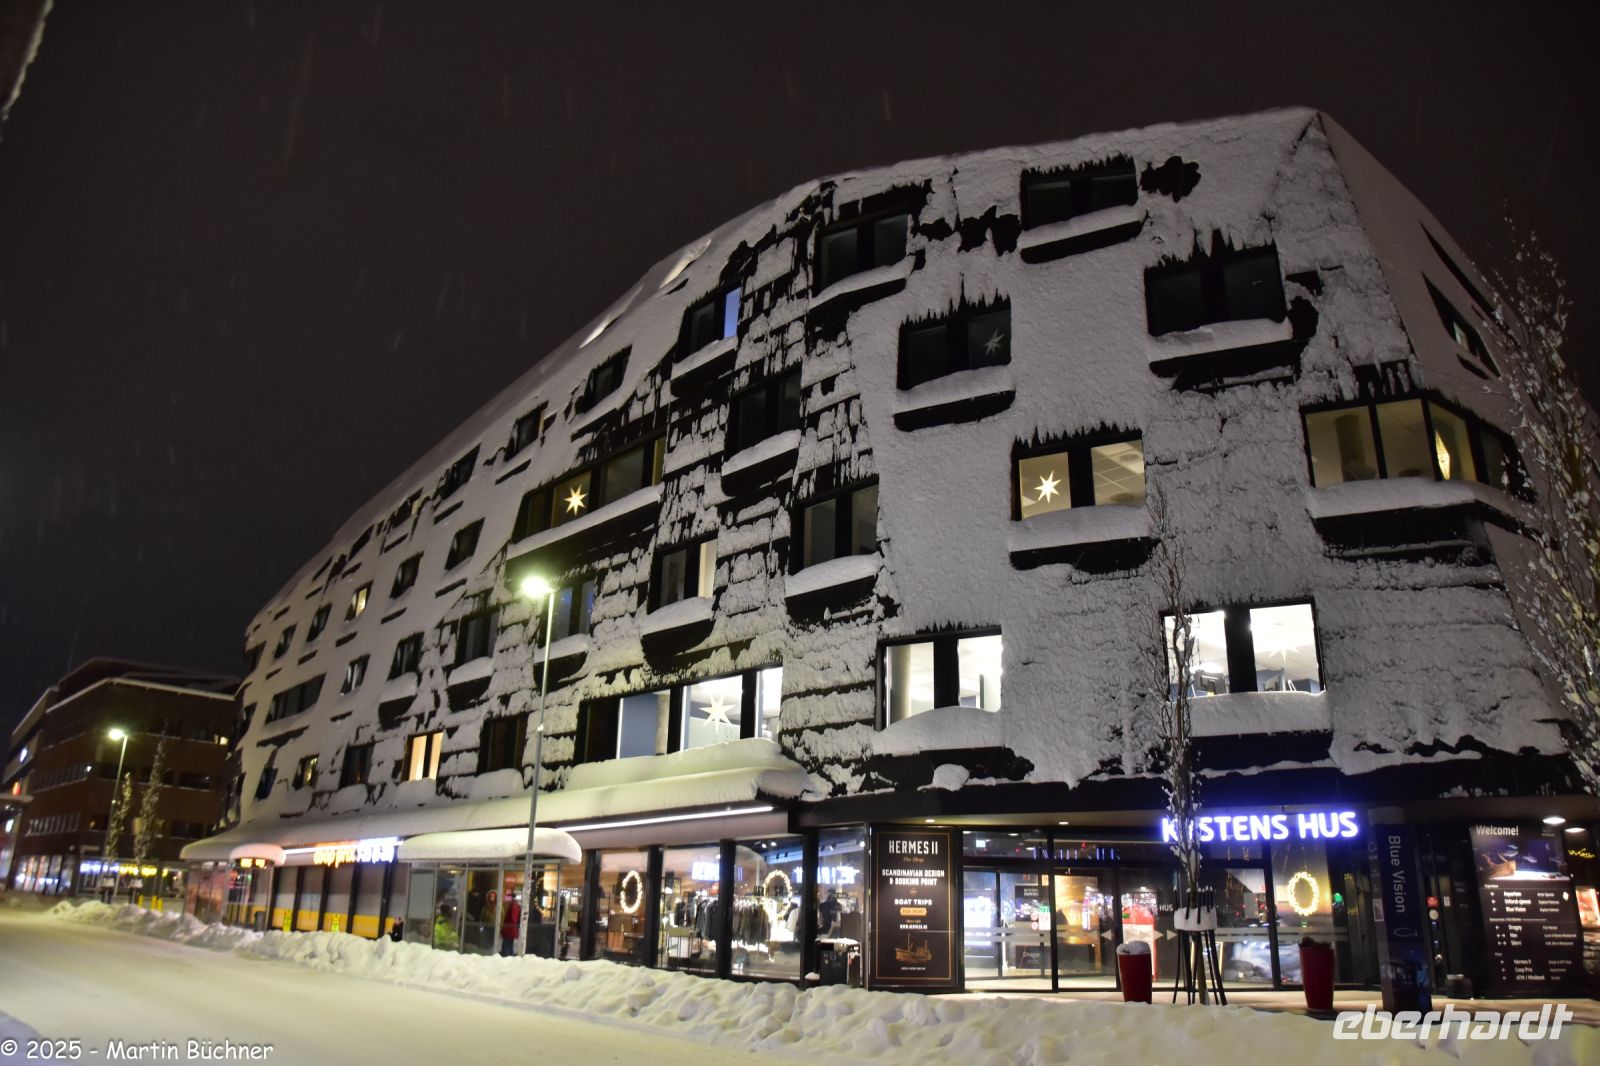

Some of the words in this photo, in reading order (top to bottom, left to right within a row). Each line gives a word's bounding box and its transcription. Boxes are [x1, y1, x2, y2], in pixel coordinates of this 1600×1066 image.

[1161, 814, 1289, 842] KSTENS
[1298, 811, 1358, 839] HUS
[1476, 825, 1519, 836] Welcome!
[888, 840, 929, 855] HERMES
[931, 841, 938, 855] II
[1388, 835, 1401, 866] Blue
[881, 868, 923, 878] SCANDINAVIAN
[924, 869, 945, 878] DESIGN
[920, 878, 938, 887] POINT
[1392, 870, 1407, 913] Vision
[894, 898, 912, 906] BOAT
[914, 898, 933, 906] TRIPS
[1159, 904, 1173, 912] HUS
